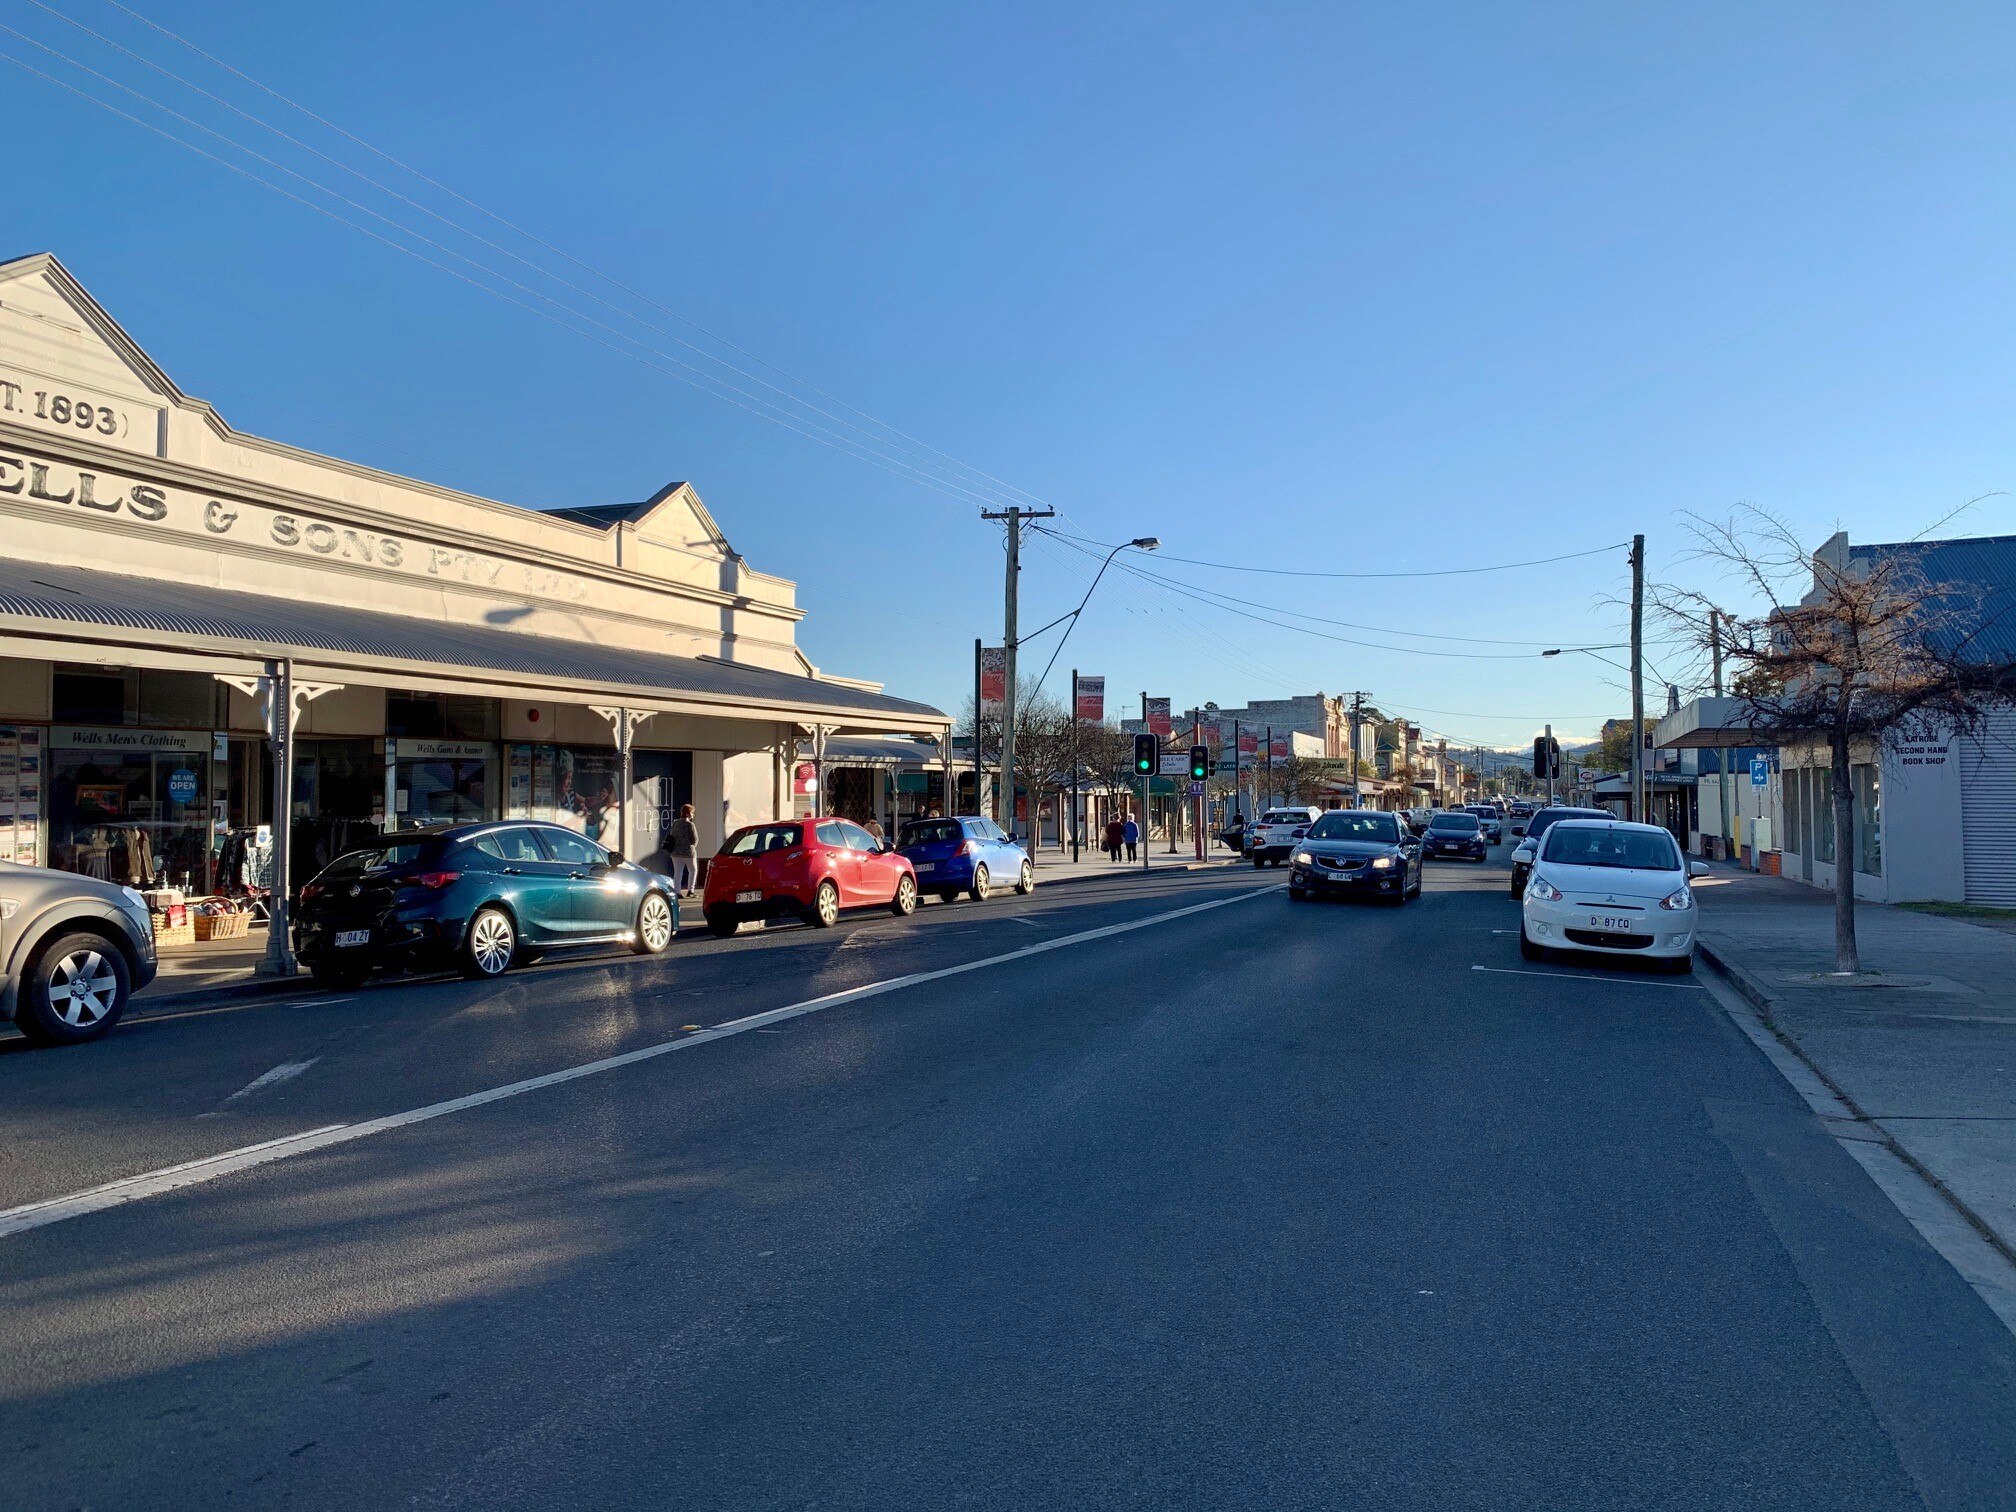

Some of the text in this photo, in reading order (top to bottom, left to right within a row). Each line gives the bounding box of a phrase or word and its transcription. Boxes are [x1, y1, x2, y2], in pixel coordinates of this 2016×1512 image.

[203, 500, 239, 534] &
[269, 514, 404, 568] SONS
[428, 547, 504, 585] PTY
[72, 731, 187, 749] Wells Men's Clothing
[417, 744, 435, 754] Wells
[455, 745, 461, 754] &
[1895, 746, 1948, 755] SECOND HAND
[1902, 757, 1946, 765] BOOK SHOP
[1754, 762, 1763, 771] P
[182, 774, 194, 782] ARE
[170, 781, 195, 790] OPEN
[644, 776, 674, 807] hill
[632, 803, 675, 832] treet
